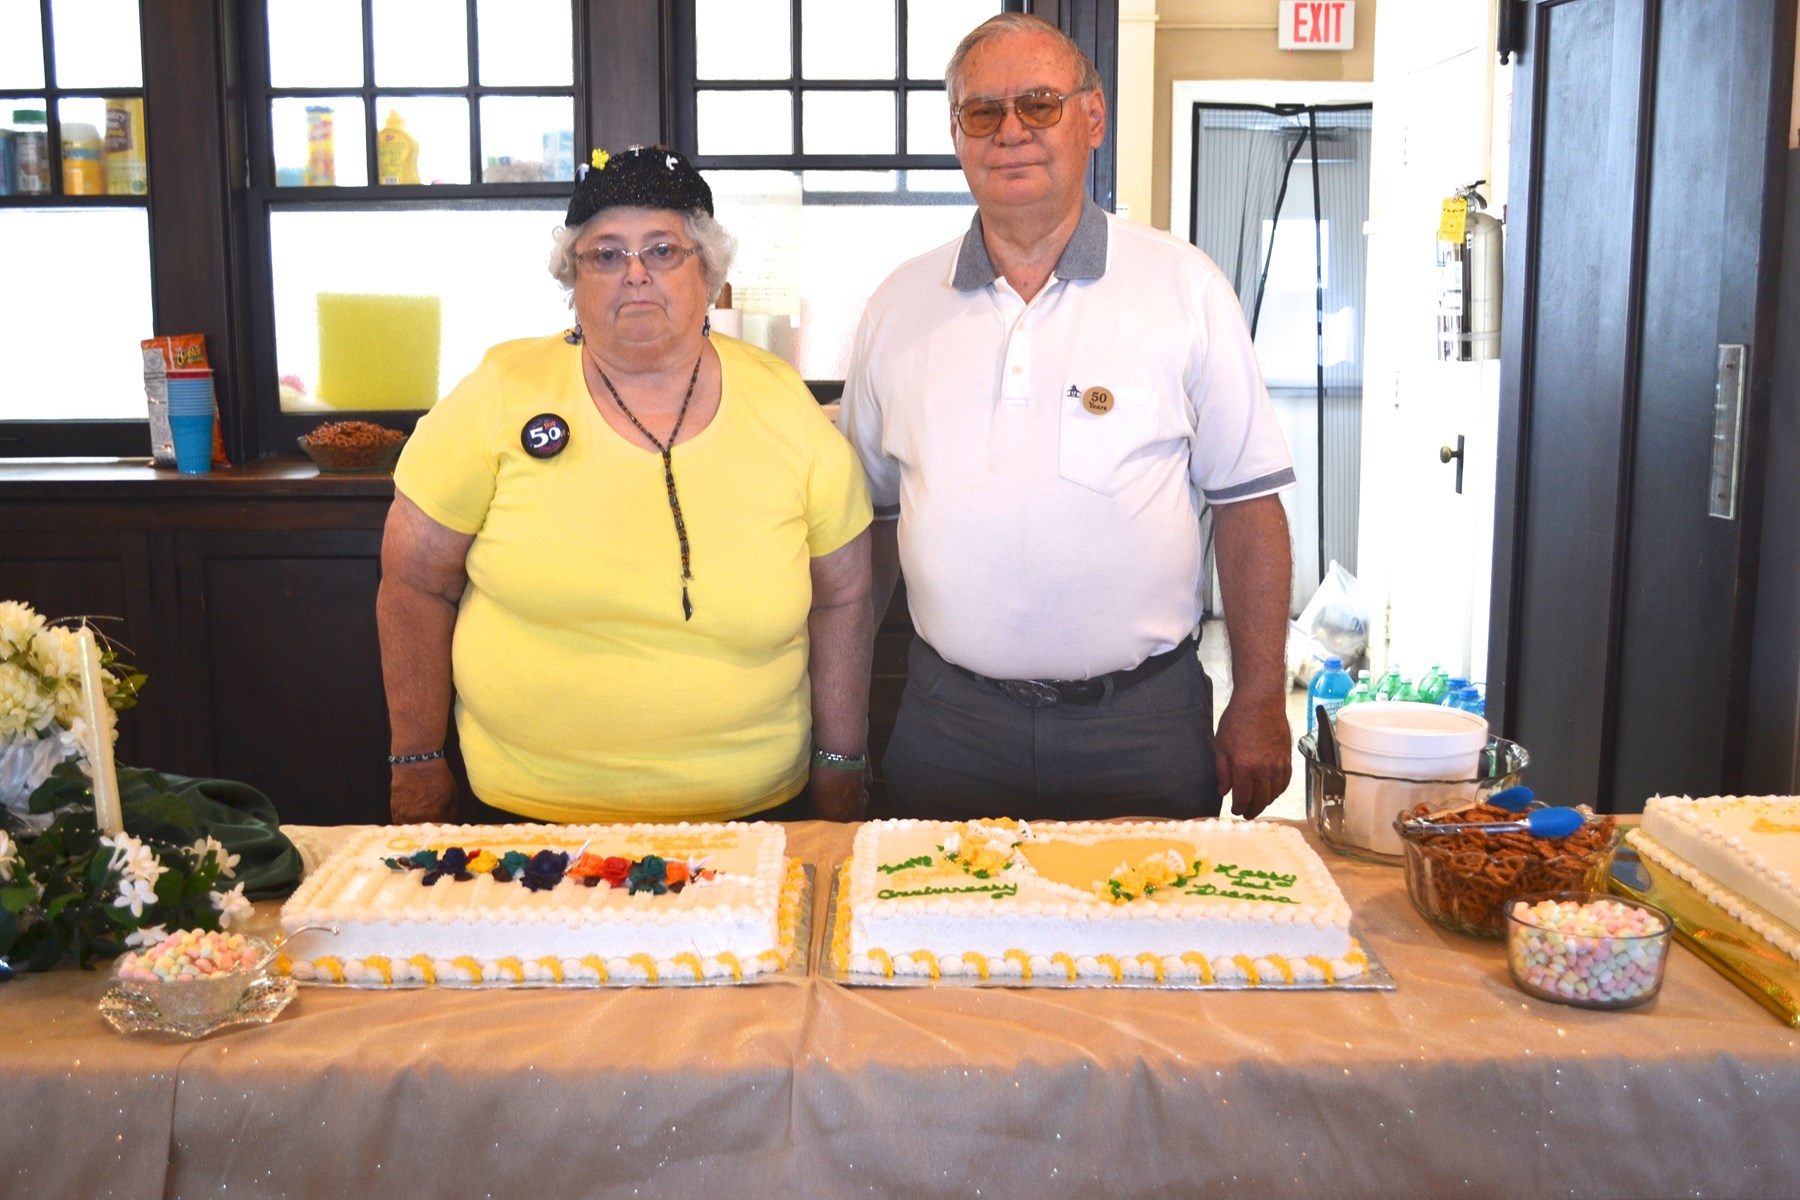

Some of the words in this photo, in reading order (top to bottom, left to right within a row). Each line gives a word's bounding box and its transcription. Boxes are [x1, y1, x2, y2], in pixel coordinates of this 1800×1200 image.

[1294, 3, 1345, 42] EXIT
[1091, 391, 1107, 403] 50
[1088, 401, 1107, 411] Years
[529, 426, 561, 449] 50
